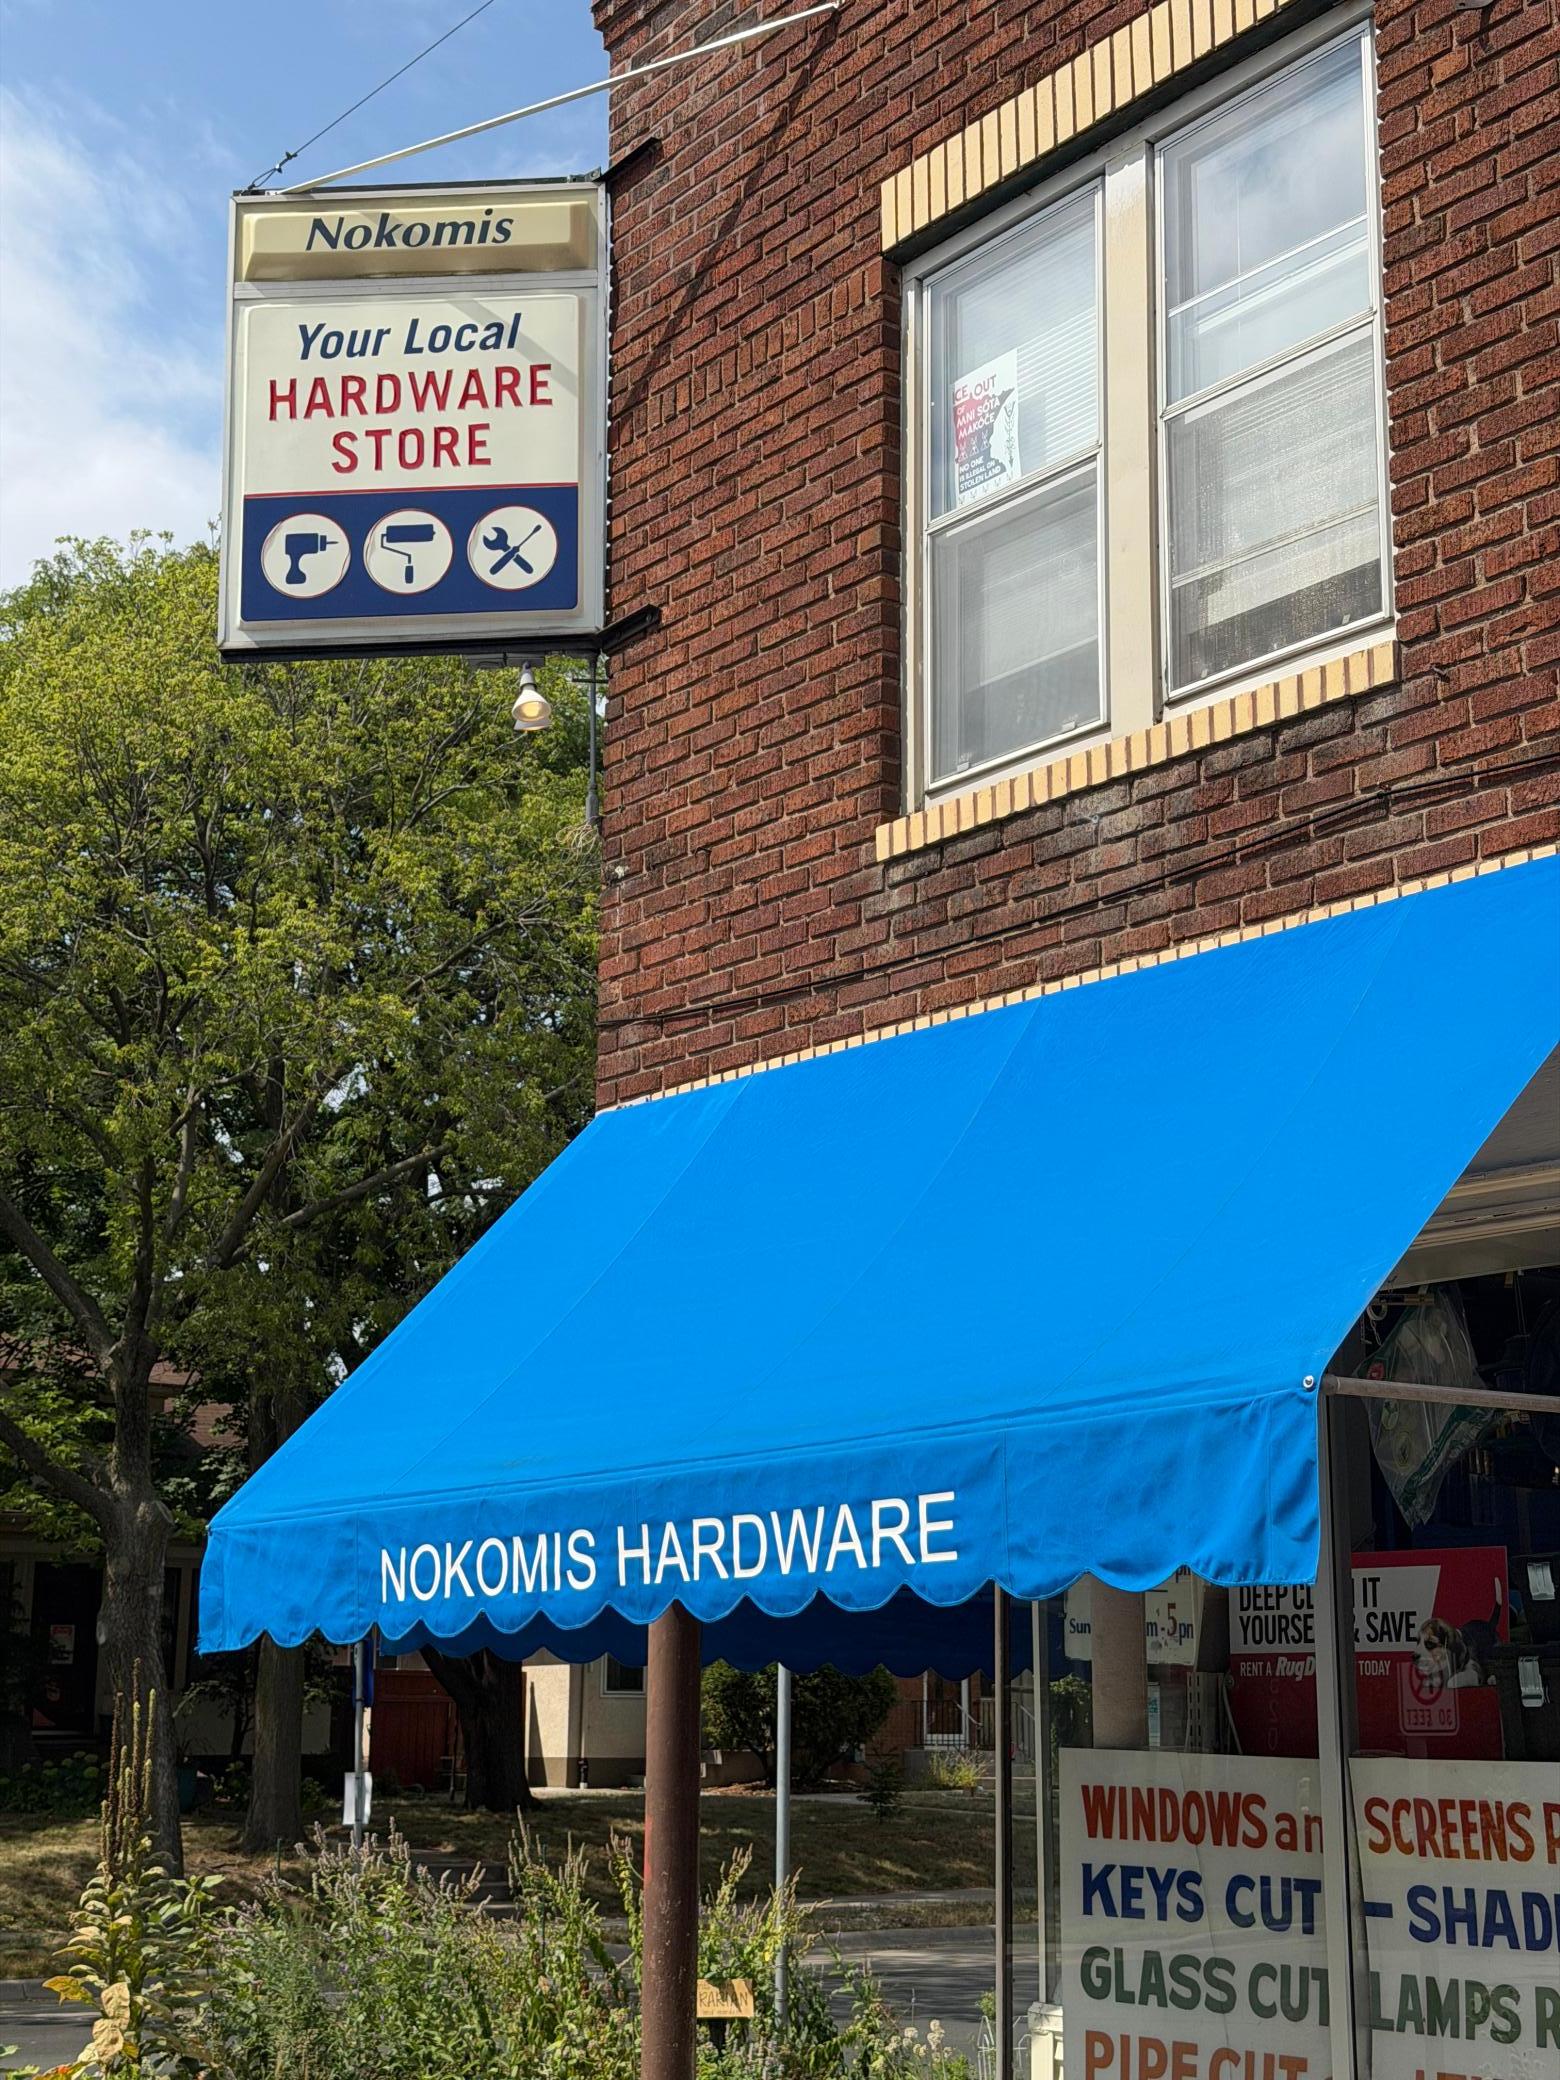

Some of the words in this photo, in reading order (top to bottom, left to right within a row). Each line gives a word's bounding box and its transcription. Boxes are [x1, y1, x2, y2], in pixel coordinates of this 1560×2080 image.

[305, 208, 515, 252] Nokomis
[298, 322, 391, 361] Your
[403, 312, 521, 355] Local
[268, 363, 553, 422] HARDWARE
[974, 374, 997, 396] OUT
[957, 409, 975, 429] MNI
[331, 422, 492, 474] STORE
[959, 463, 970, 475] NO
[970, 455, 984, 468] ONE
[960, 474, 984, 491] STOLEN
[984, 464, 1001, 480] LAND
[965, 465, 986, 479] ILLEGAL
[381, 1528, 597, 1604] NOKOMIS
[617, 1491, 959, 1587] HARDWARE
[1240, 1584, 1288, 1611] DEEP
[1362, 1577, 1381, 1608] IT
[1069, 1617, 1091, 1634] Sun
[1240, 1613, 1315, 1645] YOURSE
[1366, 1610, 1417, 1643] SAVE
[1240, 1661, 1264, 1677] RENT
[1265, 1661, 1272, 1677] A
[1358, 1660, 1391, 1676] TODAY
[1081, 1783, 1267, 1850] WINDOWS
[1274, 1806, 1323, 1854] an
[1364, 1796, 1535, 1863] SCREENS
[1081, 1862, 1204, 1922] KEYS
[1225, 1874, 1321, 1935] CUT
[1406, 1884, 1560, 1952] SHAD
[1080, 1945, 1237, 2015] GLASS
[1371, 1970, 1522, 2045] LAMPS
[1084, 2029, 1199, 2080] PIPE
